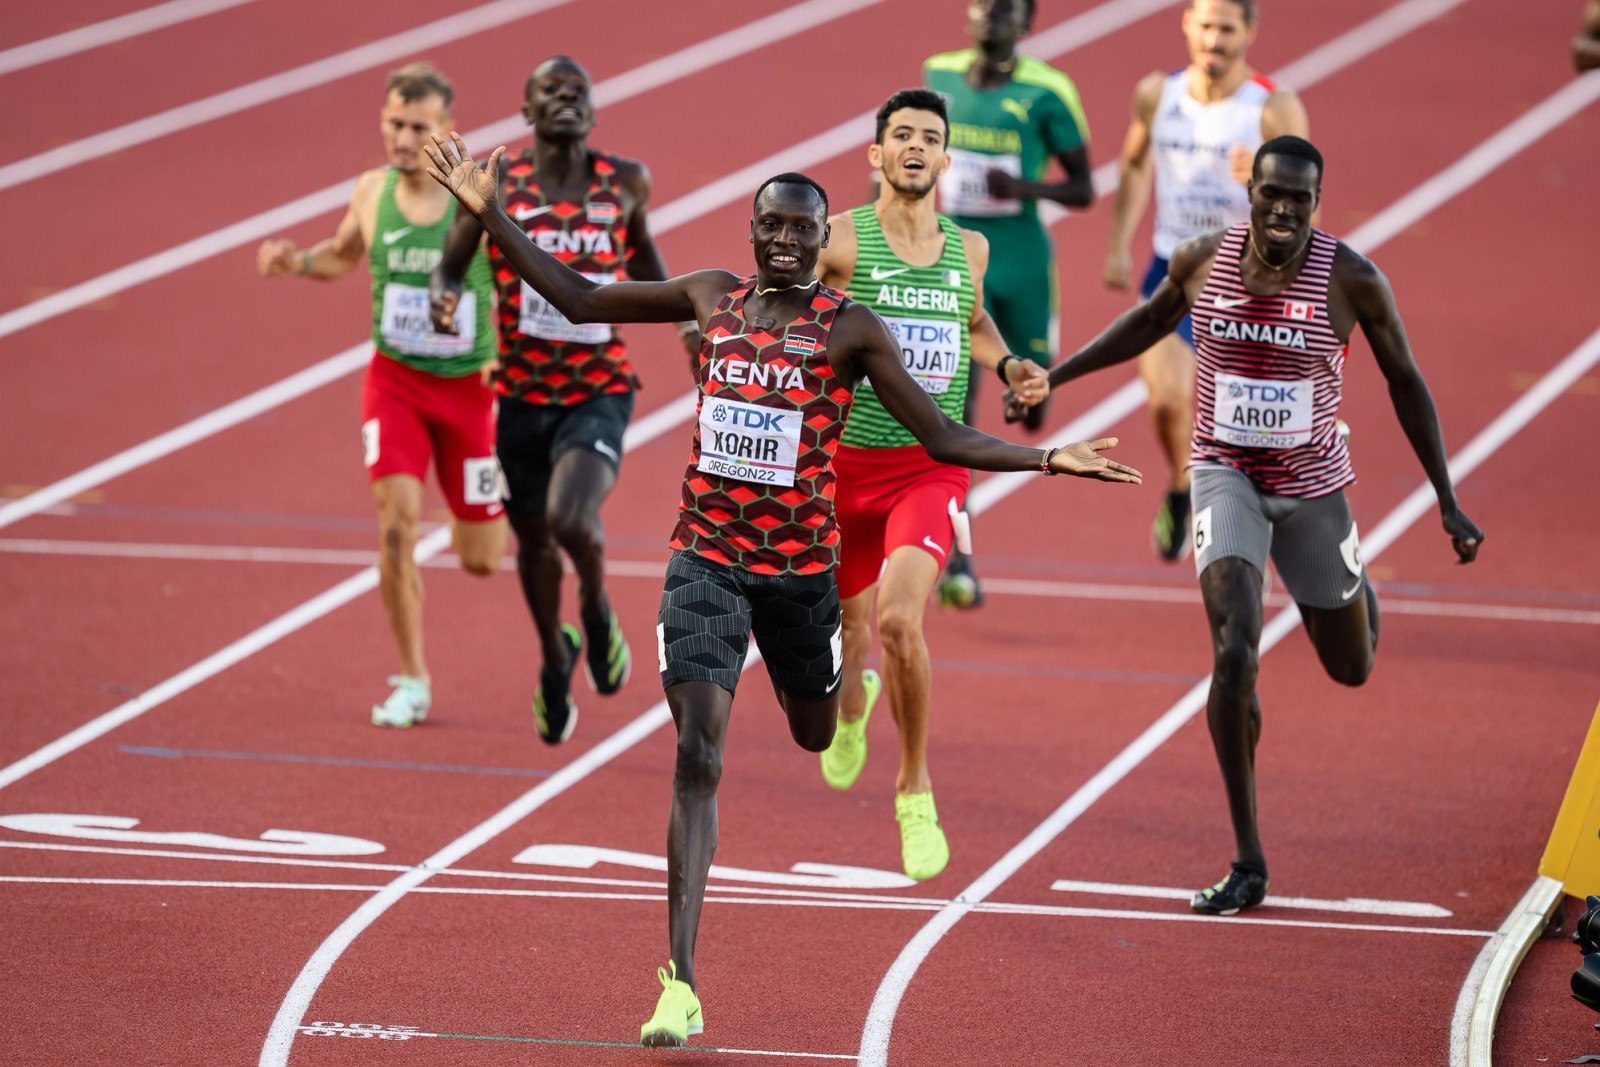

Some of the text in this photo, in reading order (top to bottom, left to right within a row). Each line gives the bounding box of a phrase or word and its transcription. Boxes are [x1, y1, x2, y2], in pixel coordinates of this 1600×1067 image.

[876, 284, 959, 313] ALGERIA
[902, 323, 952, 344] TDK
[1209, 318, 1307, 349] CANADA
[708, 358, 805, 390] KENYA
[902, 348, 956, 373] DJATI
[1243, 384, 1298, 403] TDK
[727, 405, 786, 432] TDK
[1232, 405, 1292, 428] AROP
[713, 430, 779, 462] KORIR
[1226, 432, 1296, 447] OREGON22
[479, 468, 493, 495] 8
[708, 460, 776, 482] OREGON22
[1196, 520, 1204, 549] 6
